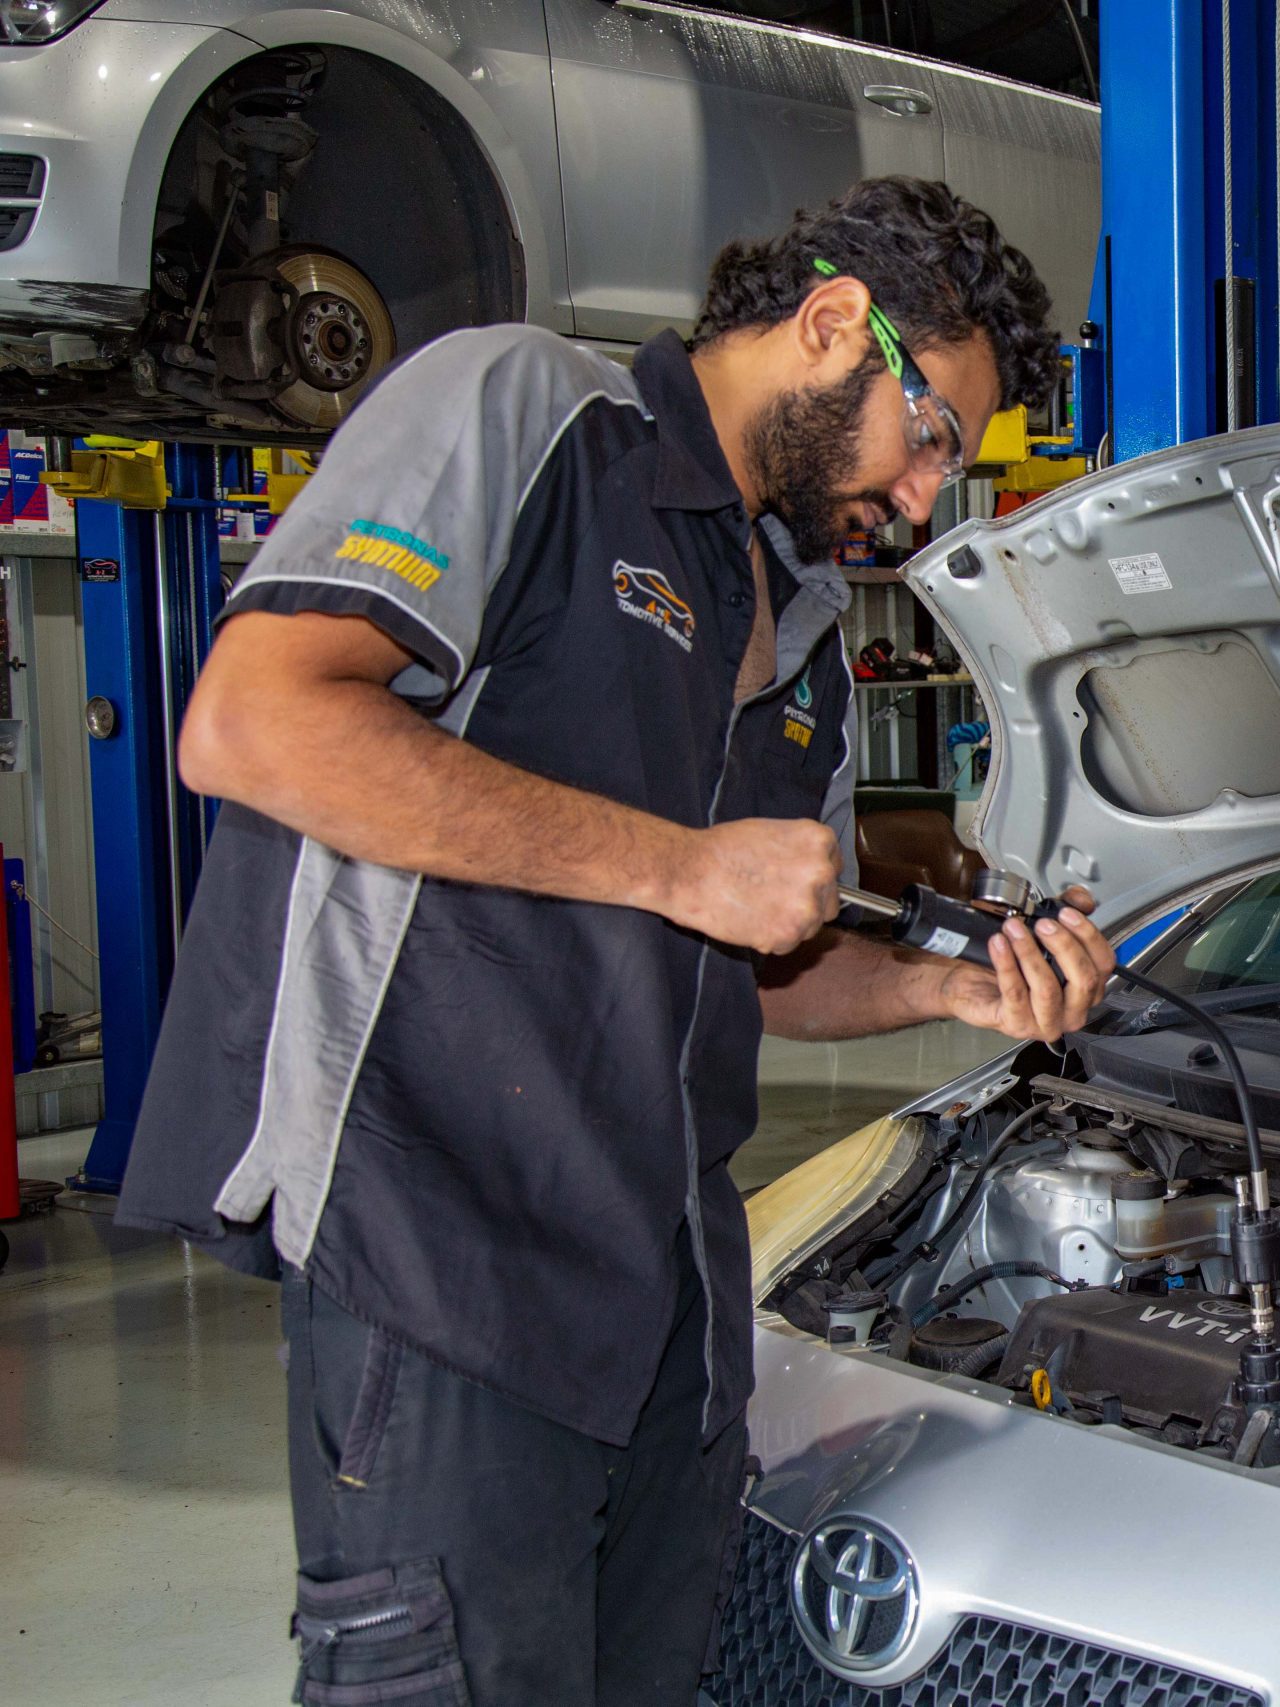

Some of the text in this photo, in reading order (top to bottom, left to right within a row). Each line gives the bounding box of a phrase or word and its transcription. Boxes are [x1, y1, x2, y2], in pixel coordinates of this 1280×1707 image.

[14, 451, 43, 460] ACDelco
[15, 473, 31, 481] Filter
[335, 534, 441, 592] SYNTIUM
[1139, 1305, 1252, 1344] VVT-i
